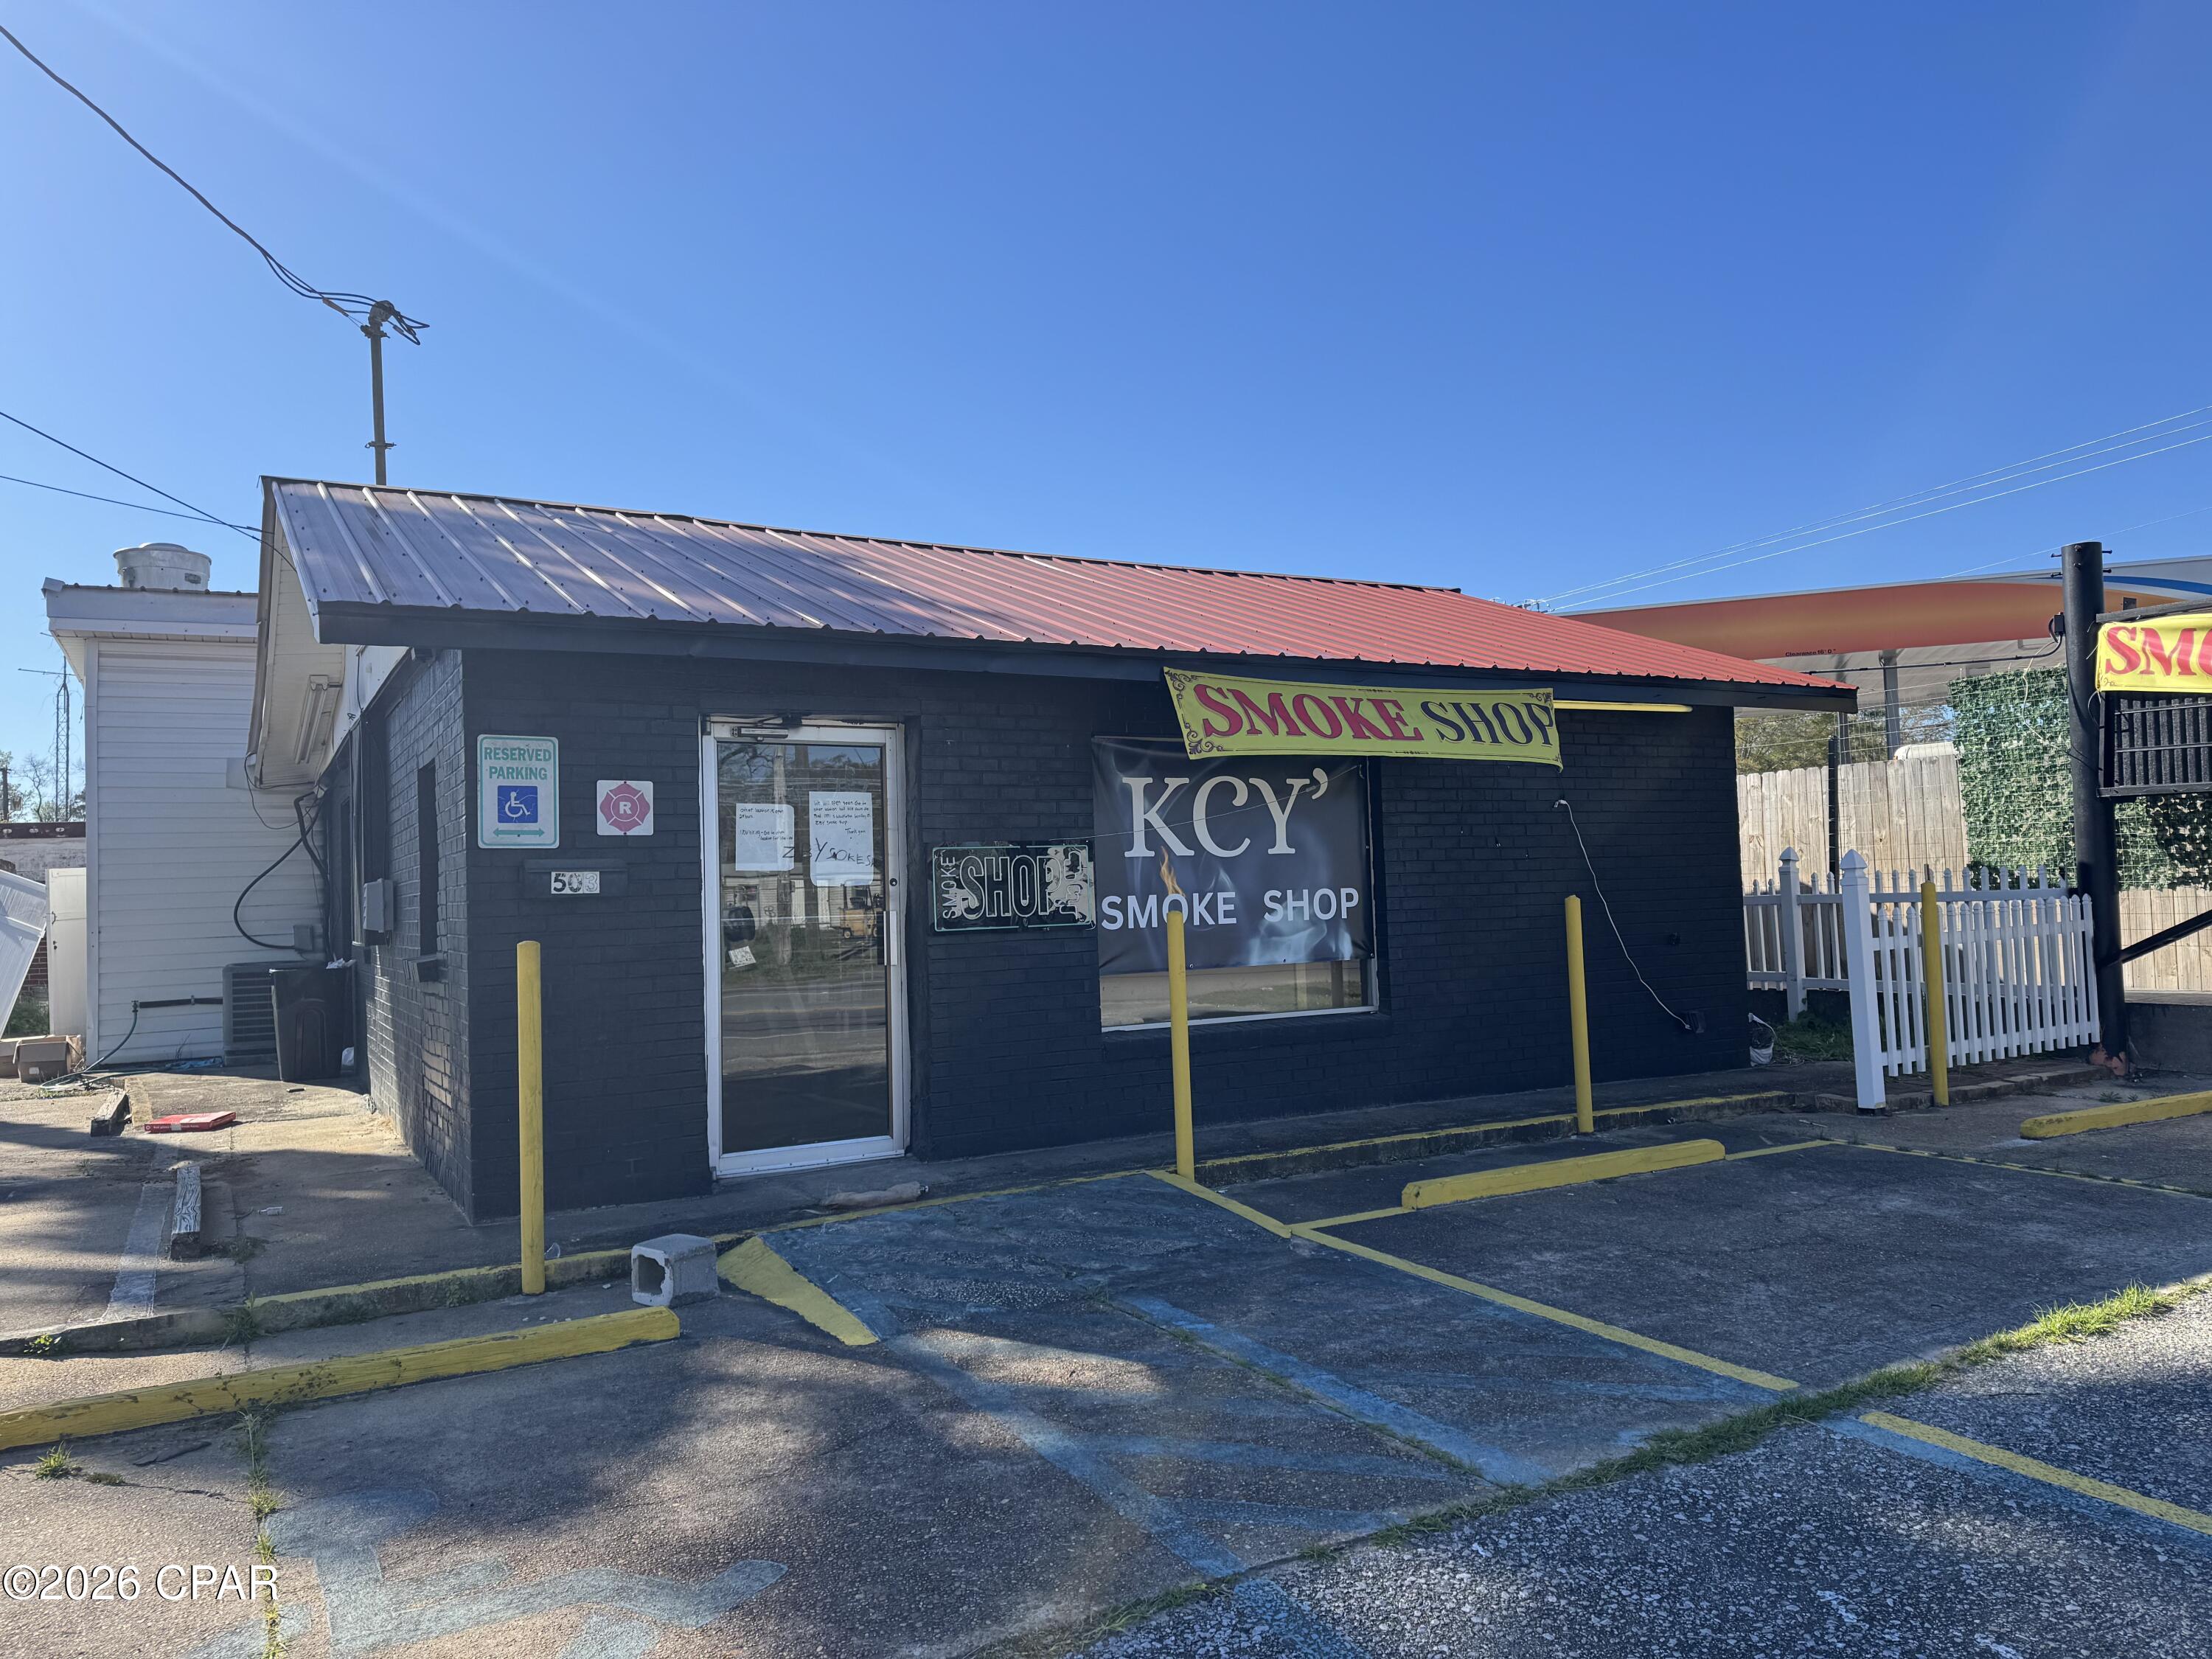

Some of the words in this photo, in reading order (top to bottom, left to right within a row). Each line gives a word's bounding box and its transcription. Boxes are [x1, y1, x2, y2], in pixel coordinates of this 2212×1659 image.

[1193, 683, 1424, 742] SMOKE
[1420, 700, 1554, 748] SHOP
[484, 746, 552, 762] RESERVED
[489, 765, 548, 780] PARKING
[619, 801, 632, 815] R
[1121, 768, 1328, 858] KCY'
[553, 872, 599, 893] 503
[940, 855, 958, 919] SMOKE
[959, 855, 1062, 920] SHOP
[1101, 891, 1238, 931] SMOKE
[1263, 887, 1360, 922] SHOP
